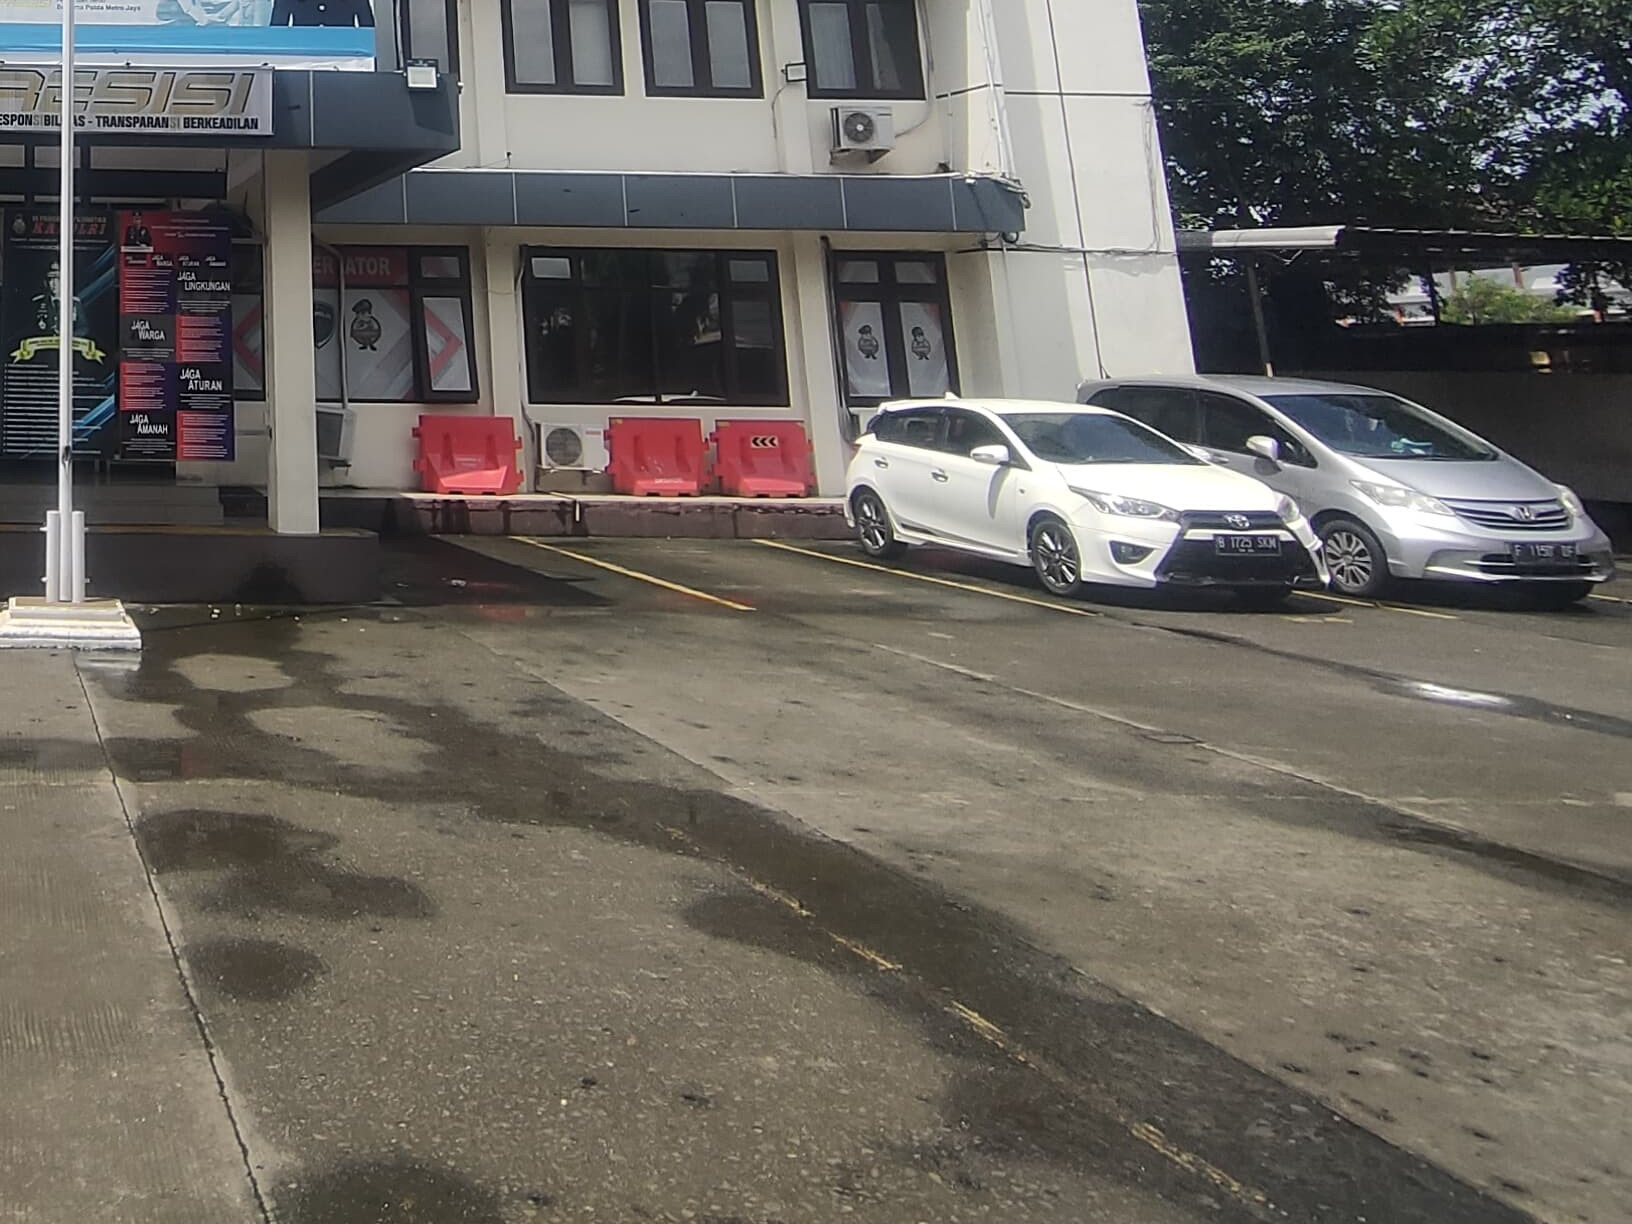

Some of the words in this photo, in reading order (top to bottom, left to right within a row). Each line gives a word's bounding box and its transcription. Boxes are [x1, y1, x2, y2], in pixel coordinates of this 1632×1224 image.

[95, 116, 181, 128] TRANSPARANSI
[183, 117, 259, 129] BERKEADILAN
[313, 255, 390, 275] ERATOR
[177, 272, 196, 280] JAGA
[184, 281, 231, 291] LINGKUNGAN
[131, 320, 150, 330] JAGA
[138, 330, 166, 340] WARGA
[180, 368, 201, 379] JAGA
[188, 380, 223, 391] ATURAN
[129, 414, 149, 424] JAGA
[137, 424, 168, 435] AMANAH
[1218, 537, 1225, 548] B
